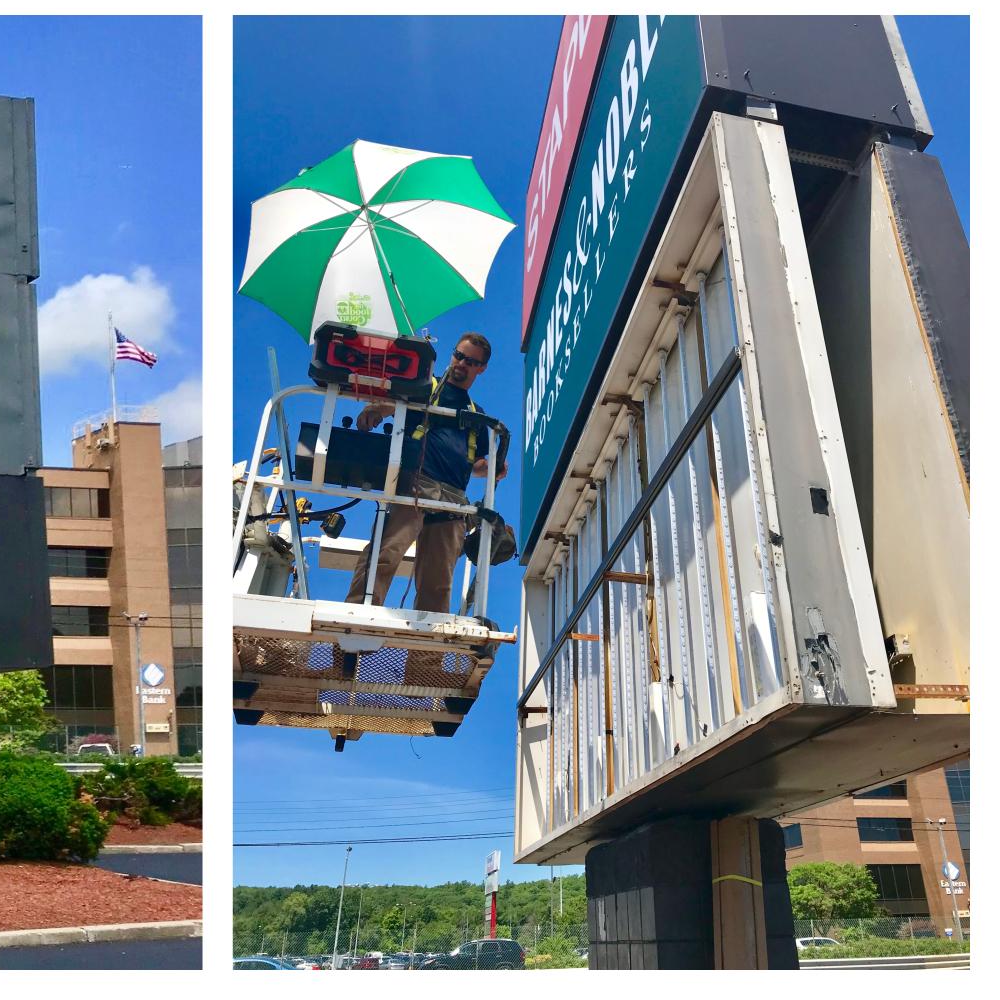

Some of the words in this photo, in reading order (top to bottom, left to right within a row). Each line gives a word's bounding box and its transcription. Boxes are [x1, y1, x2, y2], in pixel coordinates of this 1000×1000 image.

[525, 15, 666, 453] BARNES&NOBL
[533, 98, 653, 468] BOOKSELLERS
[142, 694, 167, 704] Bank
[940, 879, 967, 888] Eatern
[945, 887, 964, 896] Bnk
